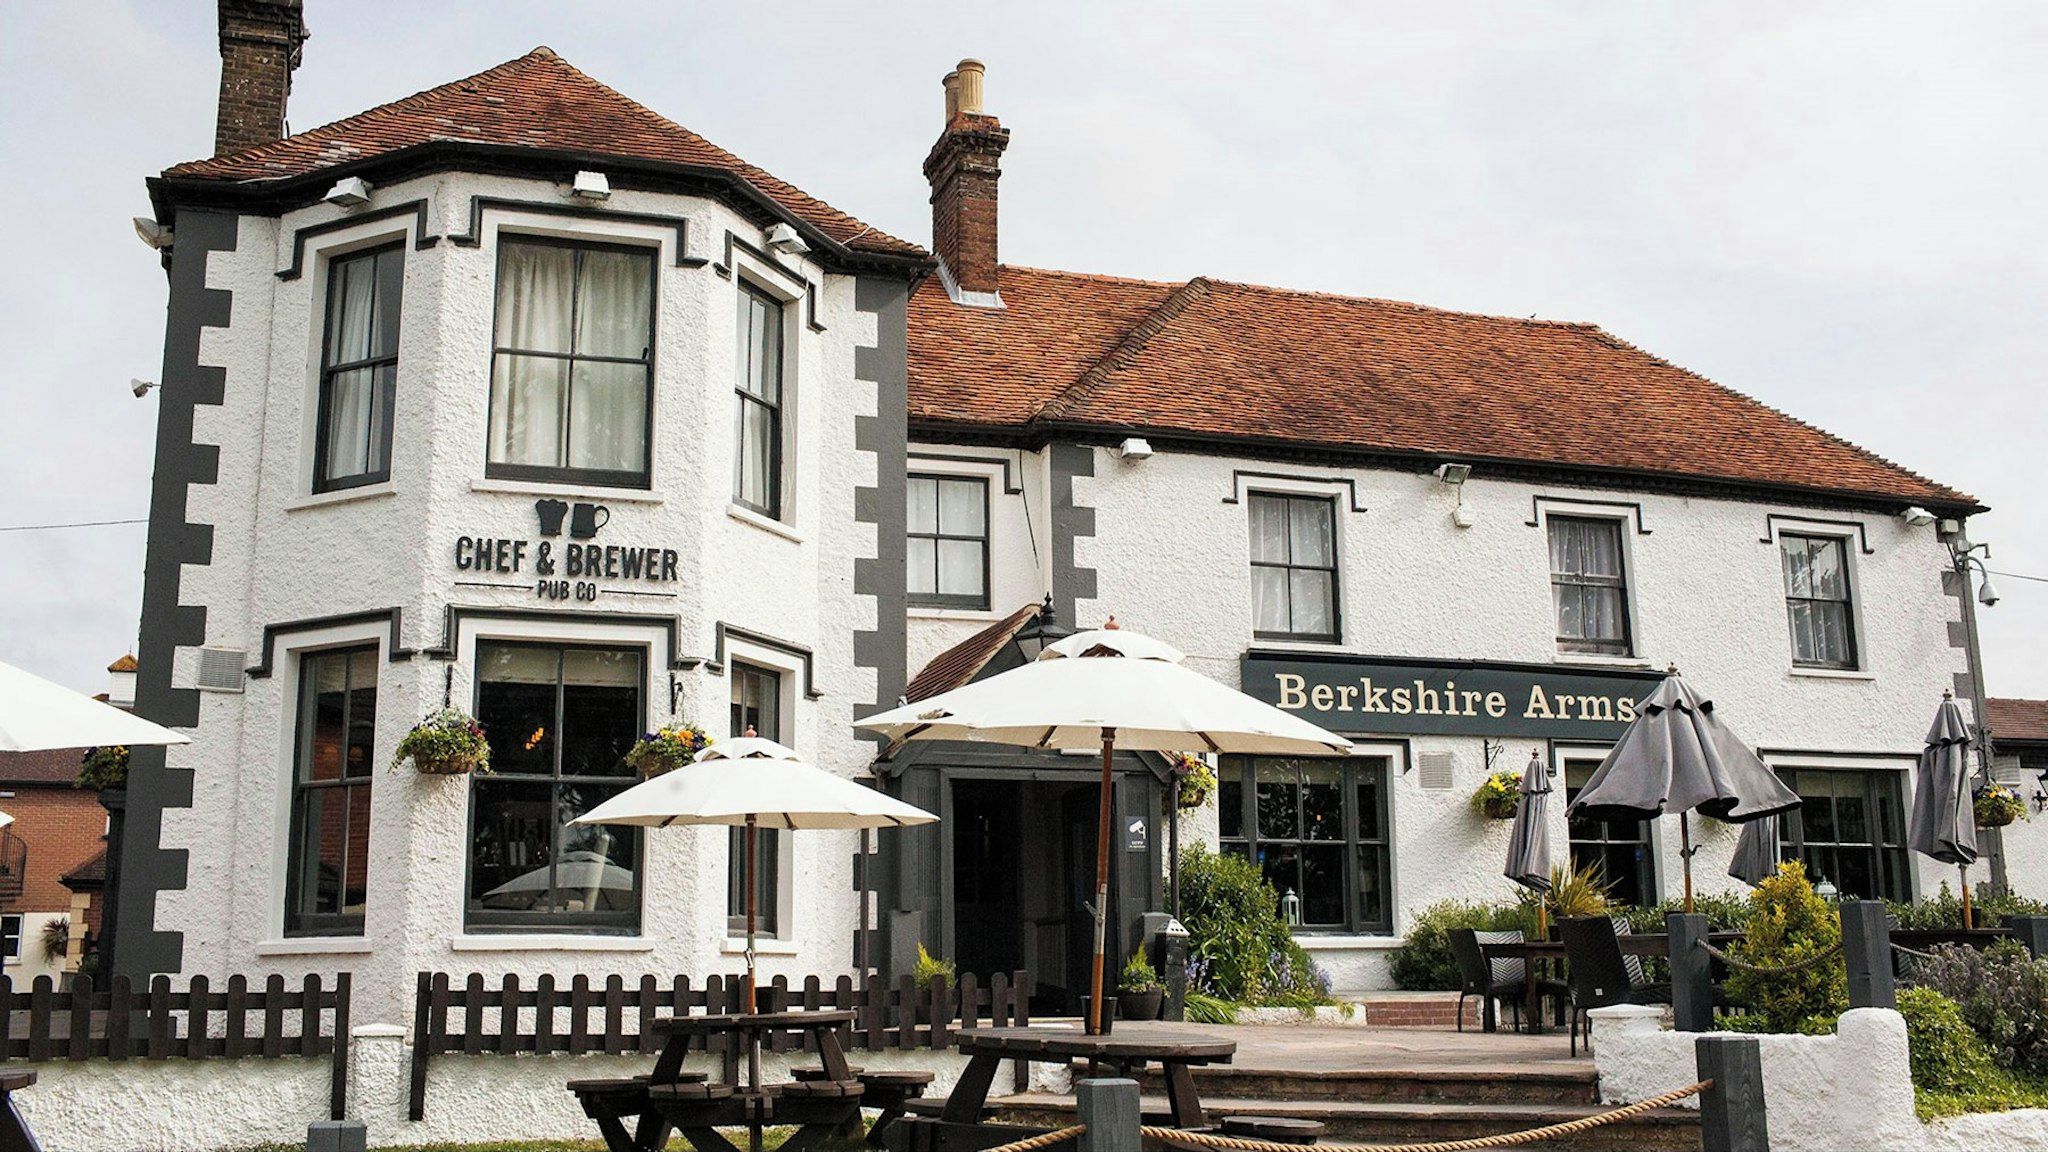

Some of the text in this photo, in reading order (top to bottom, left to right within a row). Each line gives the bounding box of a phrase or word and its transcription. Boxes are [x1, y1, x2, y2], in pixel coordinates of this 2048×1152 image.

[455, 536, 679, 581] CHEF & BREWER
[538, 580, 597, 601] PUB CO
[1274, 673, 1637, 723] Berkshire Arms
